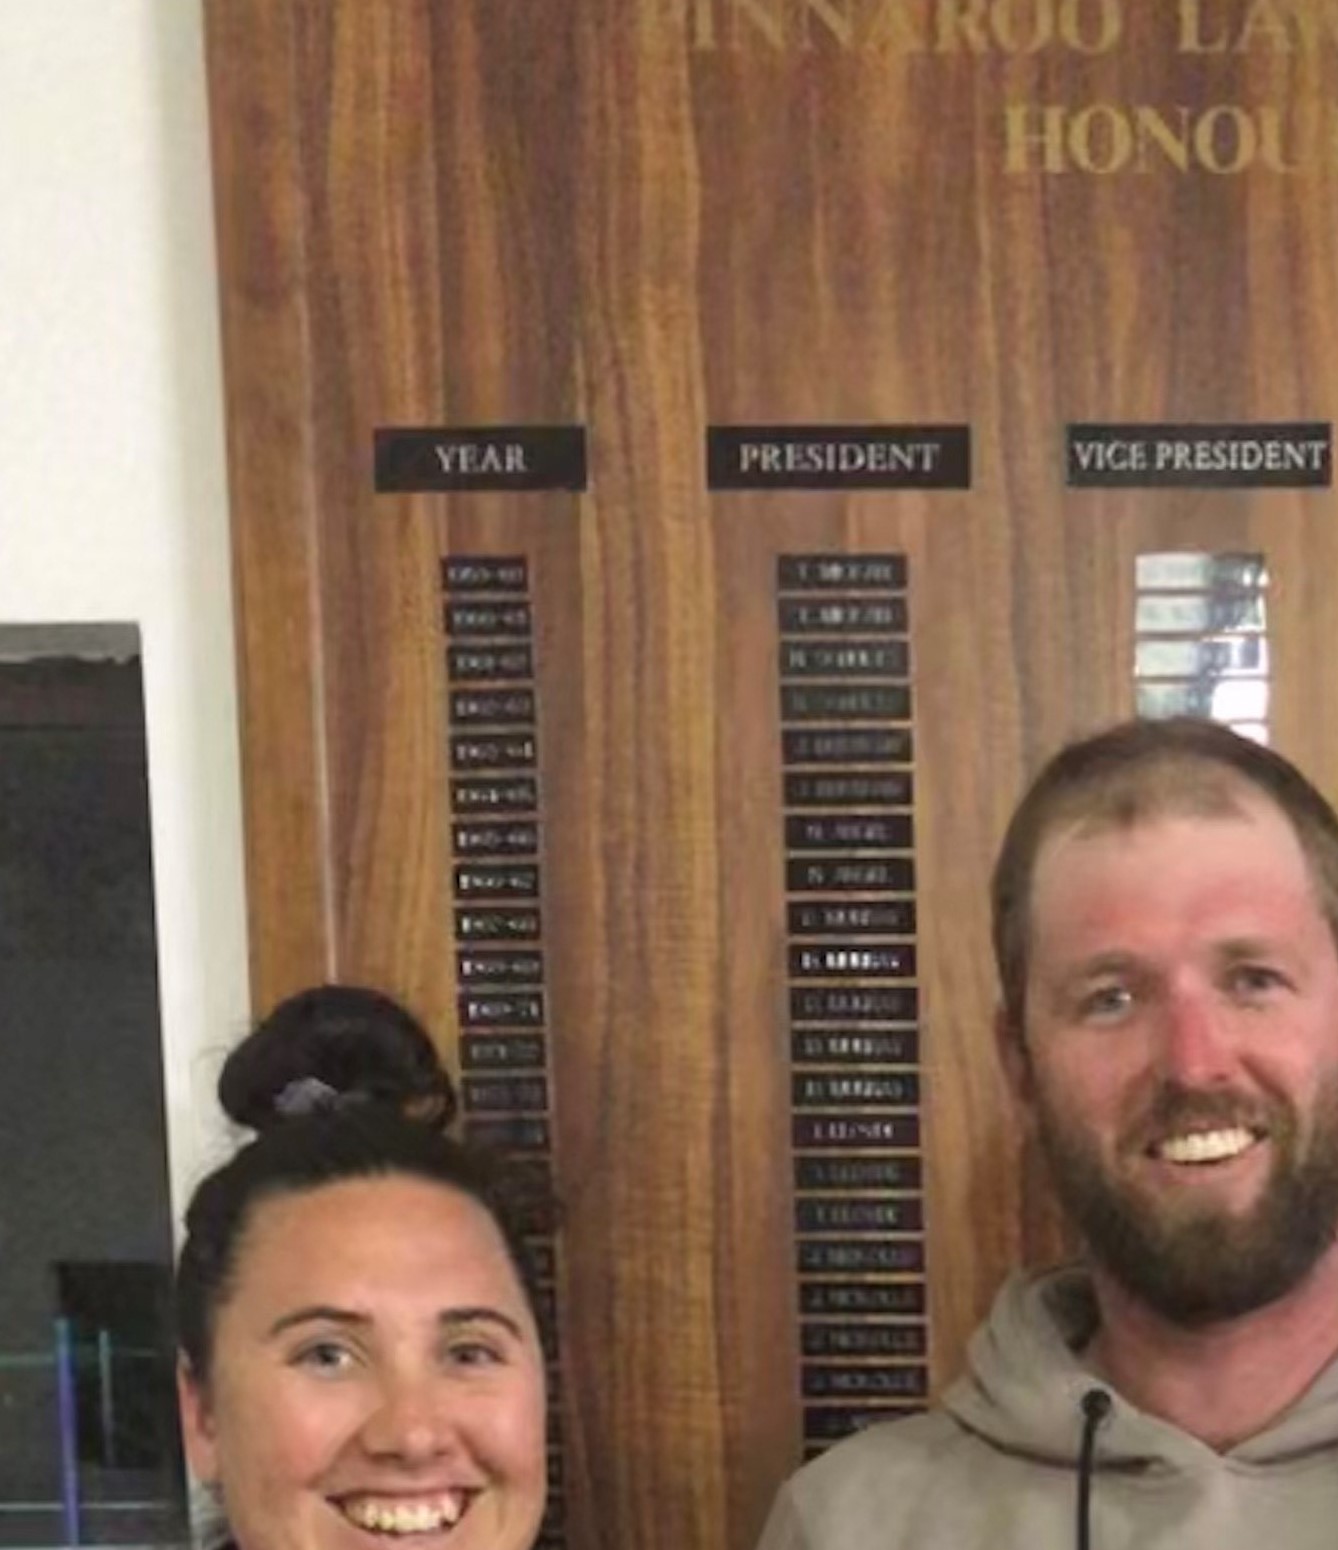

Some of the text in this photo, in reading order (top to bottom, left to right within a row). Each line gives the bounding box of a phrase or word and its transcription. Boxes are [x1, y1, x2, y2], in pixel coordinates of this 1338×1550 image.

[434, 443, 528, 473] YEAR
[738, 443, 941, 474] PRESIDENT
[1072, 440, 1328, 472] VICE PRESIDENT
